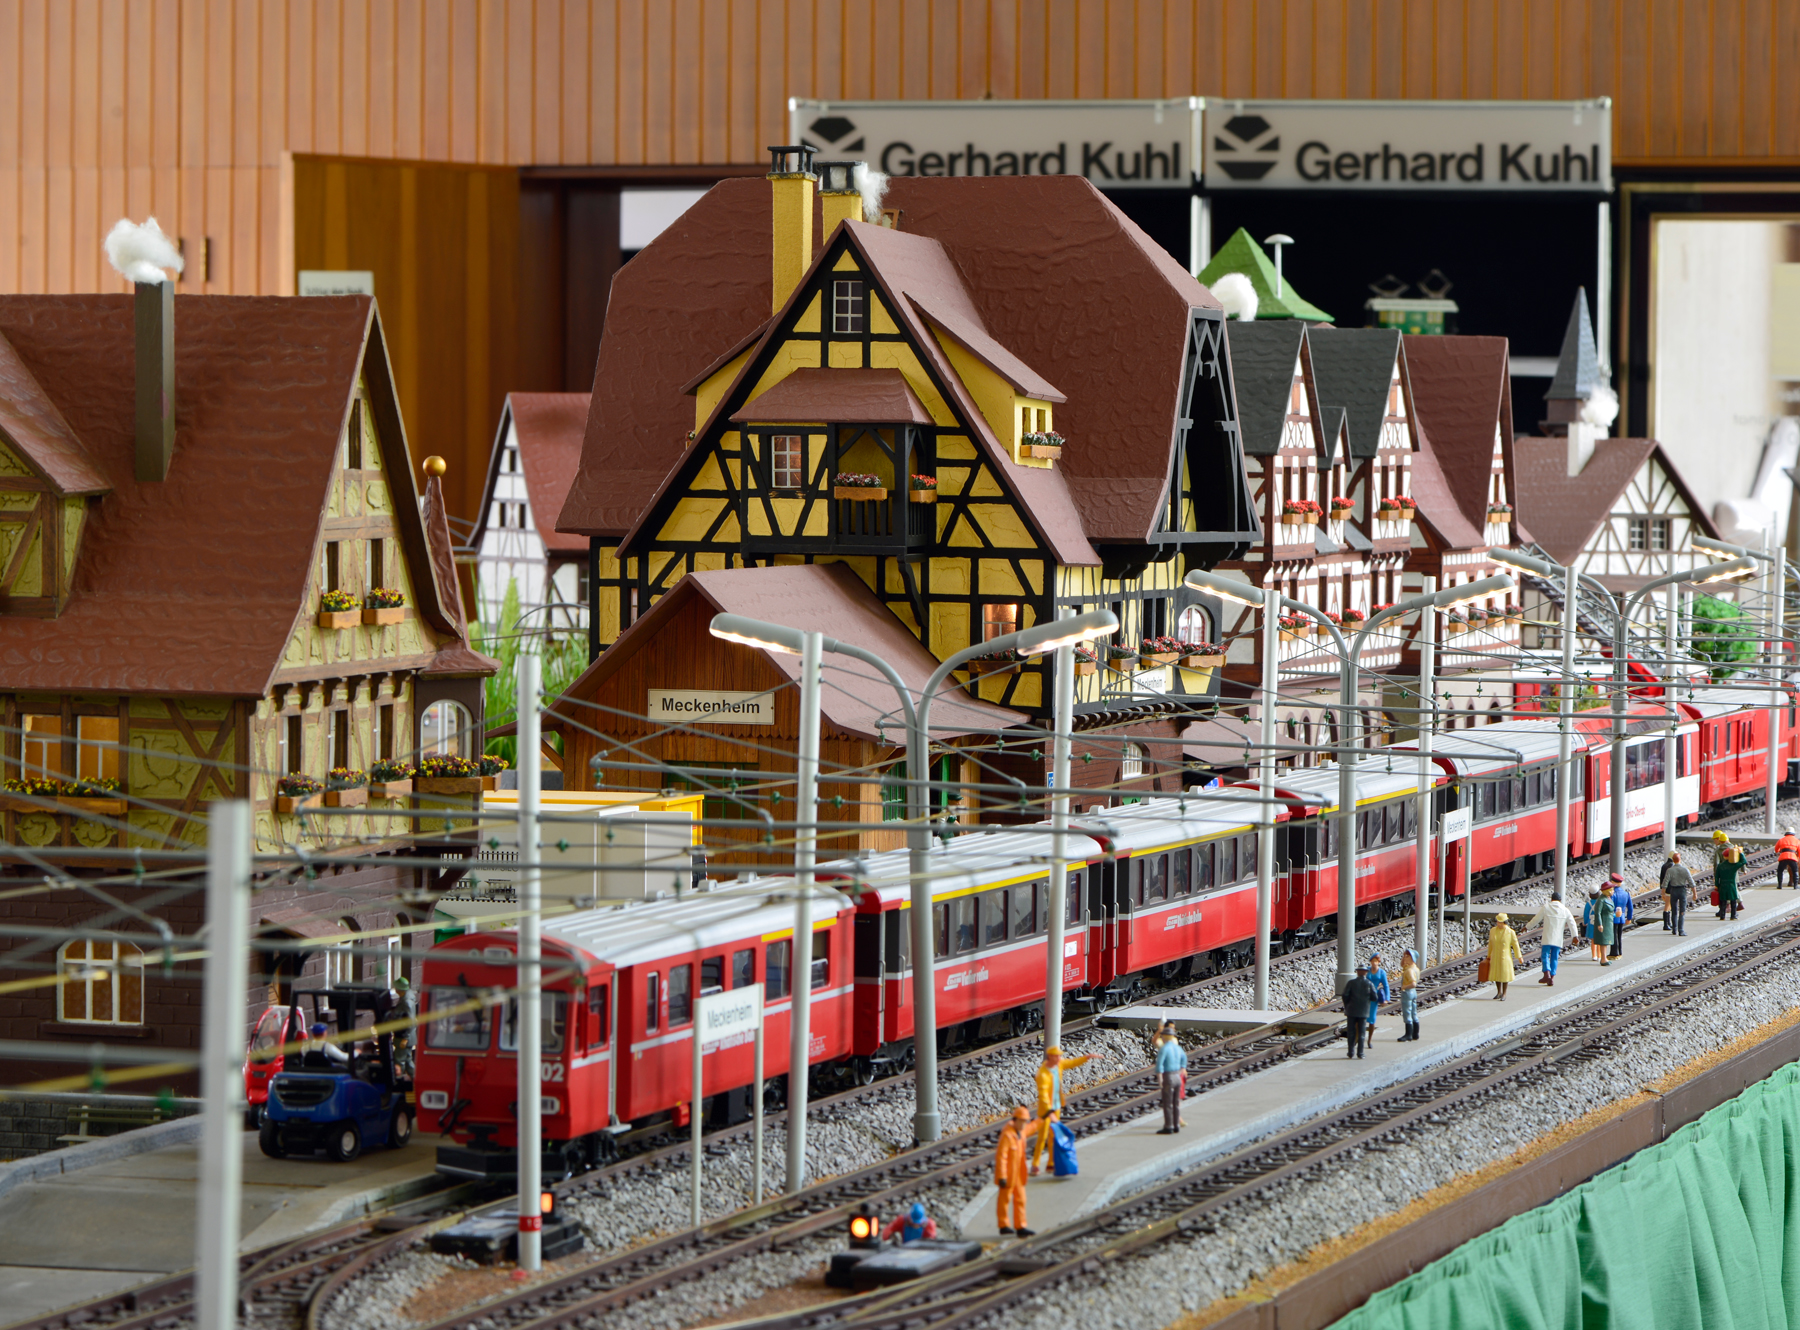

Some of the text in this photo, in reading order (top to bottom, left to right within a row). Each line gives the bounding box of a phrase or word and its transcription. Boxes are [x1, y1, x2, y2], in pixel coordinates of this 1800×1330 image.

[881, 141, 1181, 181] Gerhard Kuhl
[1295, 141, 1600, 182] Gerhard Kuhl
[1136, 676, 1163, 690] Meckenheim
[661, 697, 760, 714] Meckenheim
[660, 979, 669, 1002] 2
[707, 1002, 753, 1029] Meckenheim
